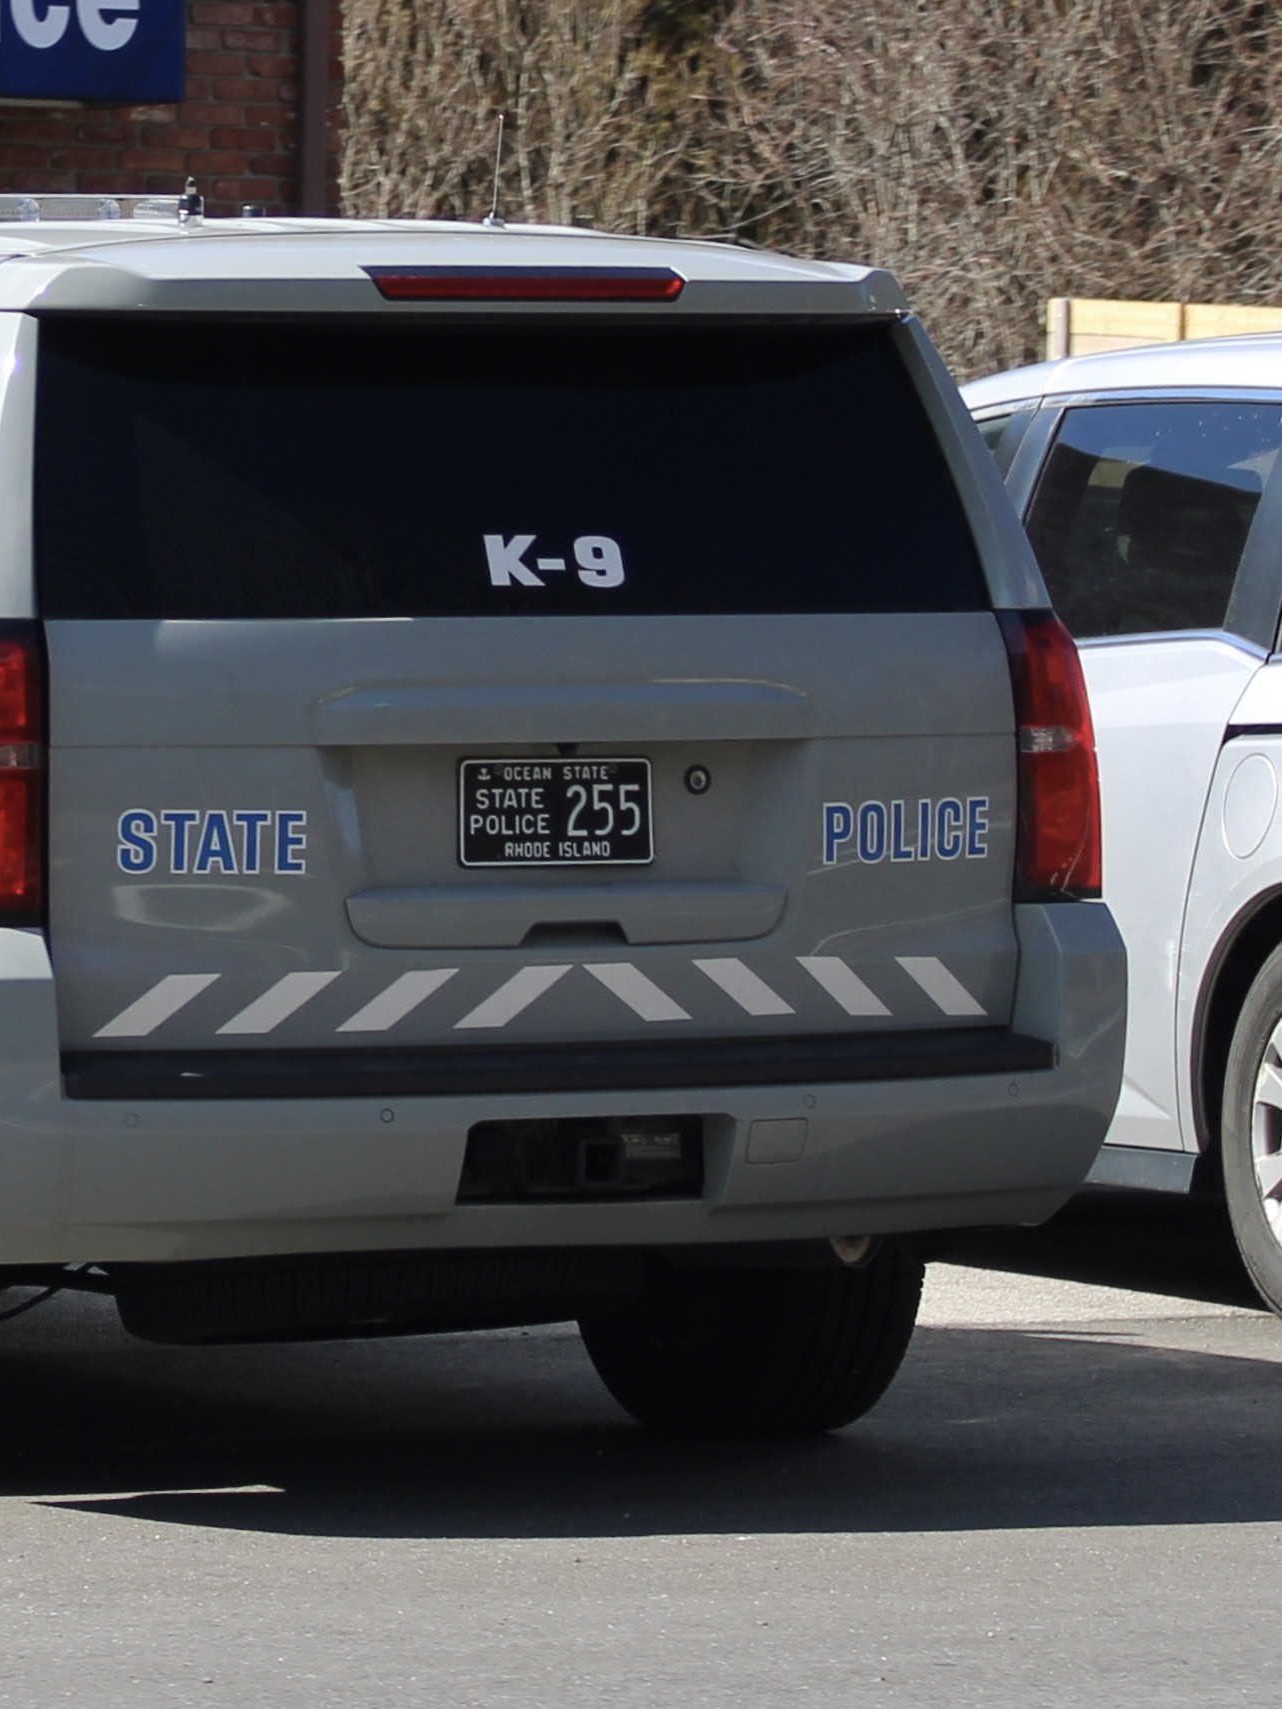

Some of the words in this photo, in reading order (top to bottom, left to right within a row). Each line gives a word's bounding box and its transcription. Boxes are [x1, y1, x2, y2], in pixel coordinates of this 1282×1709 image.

[483, 534, 625, 588] K-9
[503, 766, 552, 781] OCEAN
[563, 765, 609, 780] STATE
[476, 788, 544, 809] STATE
[566, 783, 641, 837] 255
[117, 808, 307, 875] STATE
[470, 813, 550, 835] POLICE
[823, 796, 989, 865] POLICE
[504, 842, 551, 858] RHODE
[558, 841, 610, 857] ISLAND
